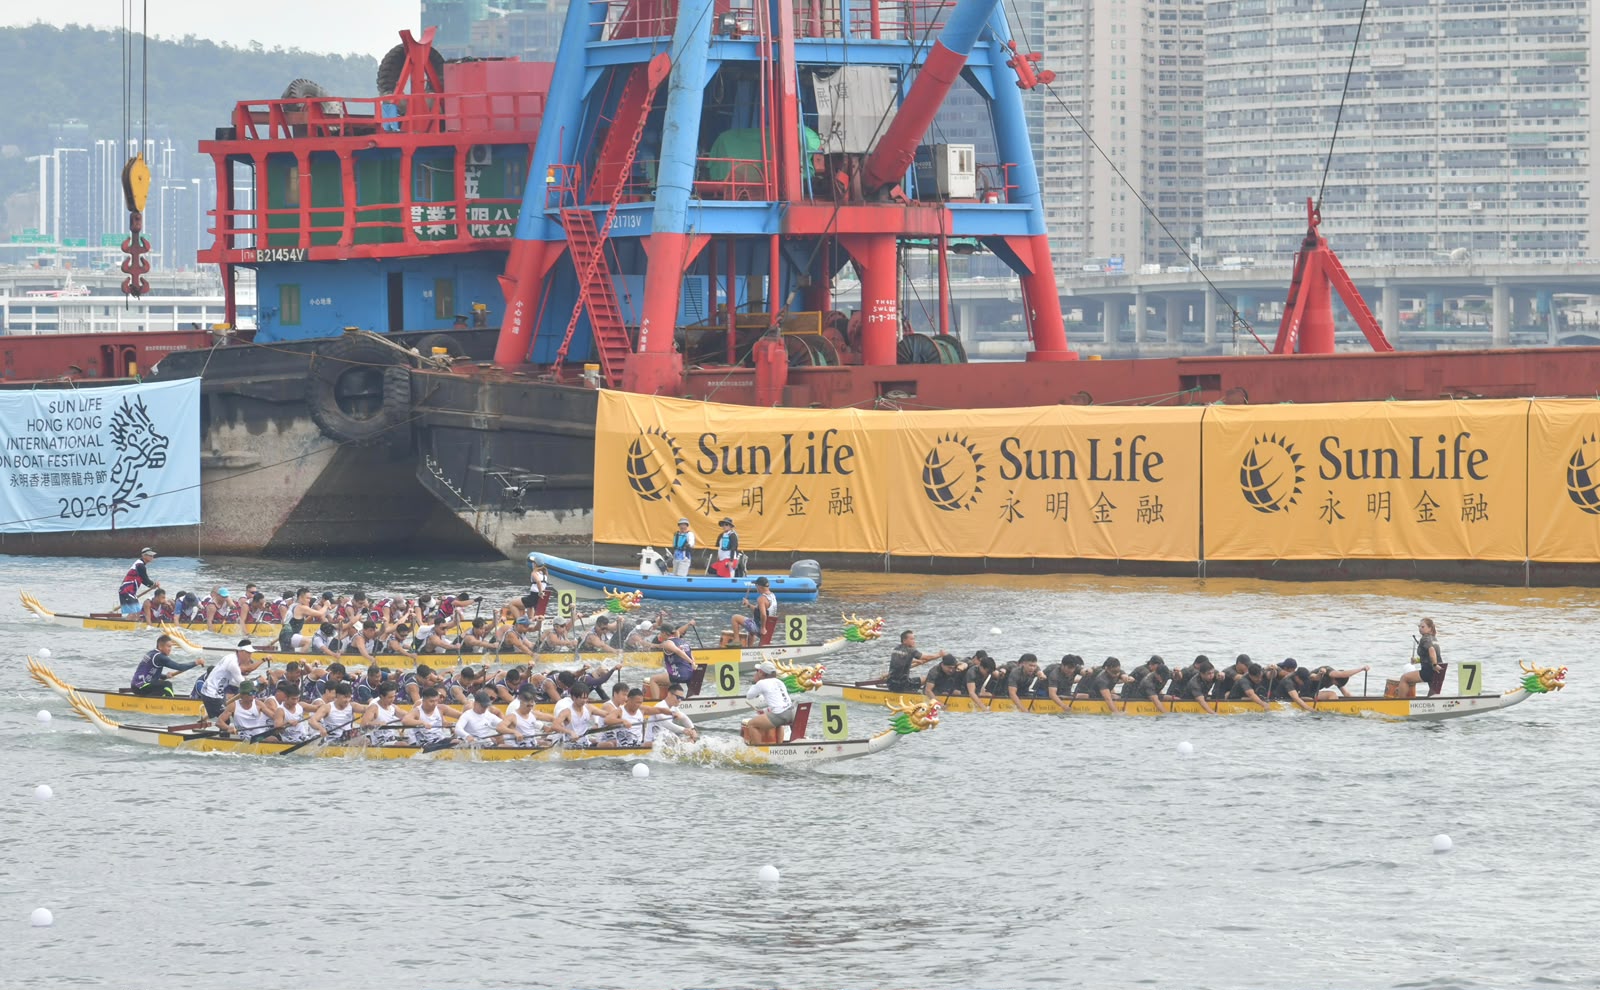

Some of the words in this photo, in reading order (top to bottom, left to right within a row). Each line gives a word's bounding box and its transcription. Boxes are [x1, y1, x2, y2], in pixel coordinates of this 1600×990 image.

[257, 248, 305, 262] B21454V
[49, 400, 76, 414] SUN
[79, 398, 102, 412] LIFE
[27, 418, 63, 432] HONG
[66, 416, 102, 431] KONG
[6, 434, 104, 450] INTERNATIONAL
[697, 432, 772, 476] Sun
[781, 428, 855, 476] Life
[13, 454, 45, 469] BOAT
[47, 452, 106, 468] FESTIVAL
[1000, 436, 1079, 481] Sun
[1087, 434, 1164, 483] Life
[1318, 435, 1400, 481] Sun
[1409, 431, 1489, 481] Life
[9, 470, 108, 488] 永明香港國際龍舟節
[58, 495, 108, 519] 2026
[695, 483, 855, 517] 永明金融
[999, 490, 1165, 525] 永明金融
[1318, 490, 1489, 525] 永明金融
[561, 592, 573, 615] 9
[789, 617, 801, 642] 8
[720, 664, 735, 691] 6
[1462, 664, 1477, 690] 7
[826, 705, 843, 734] 5
